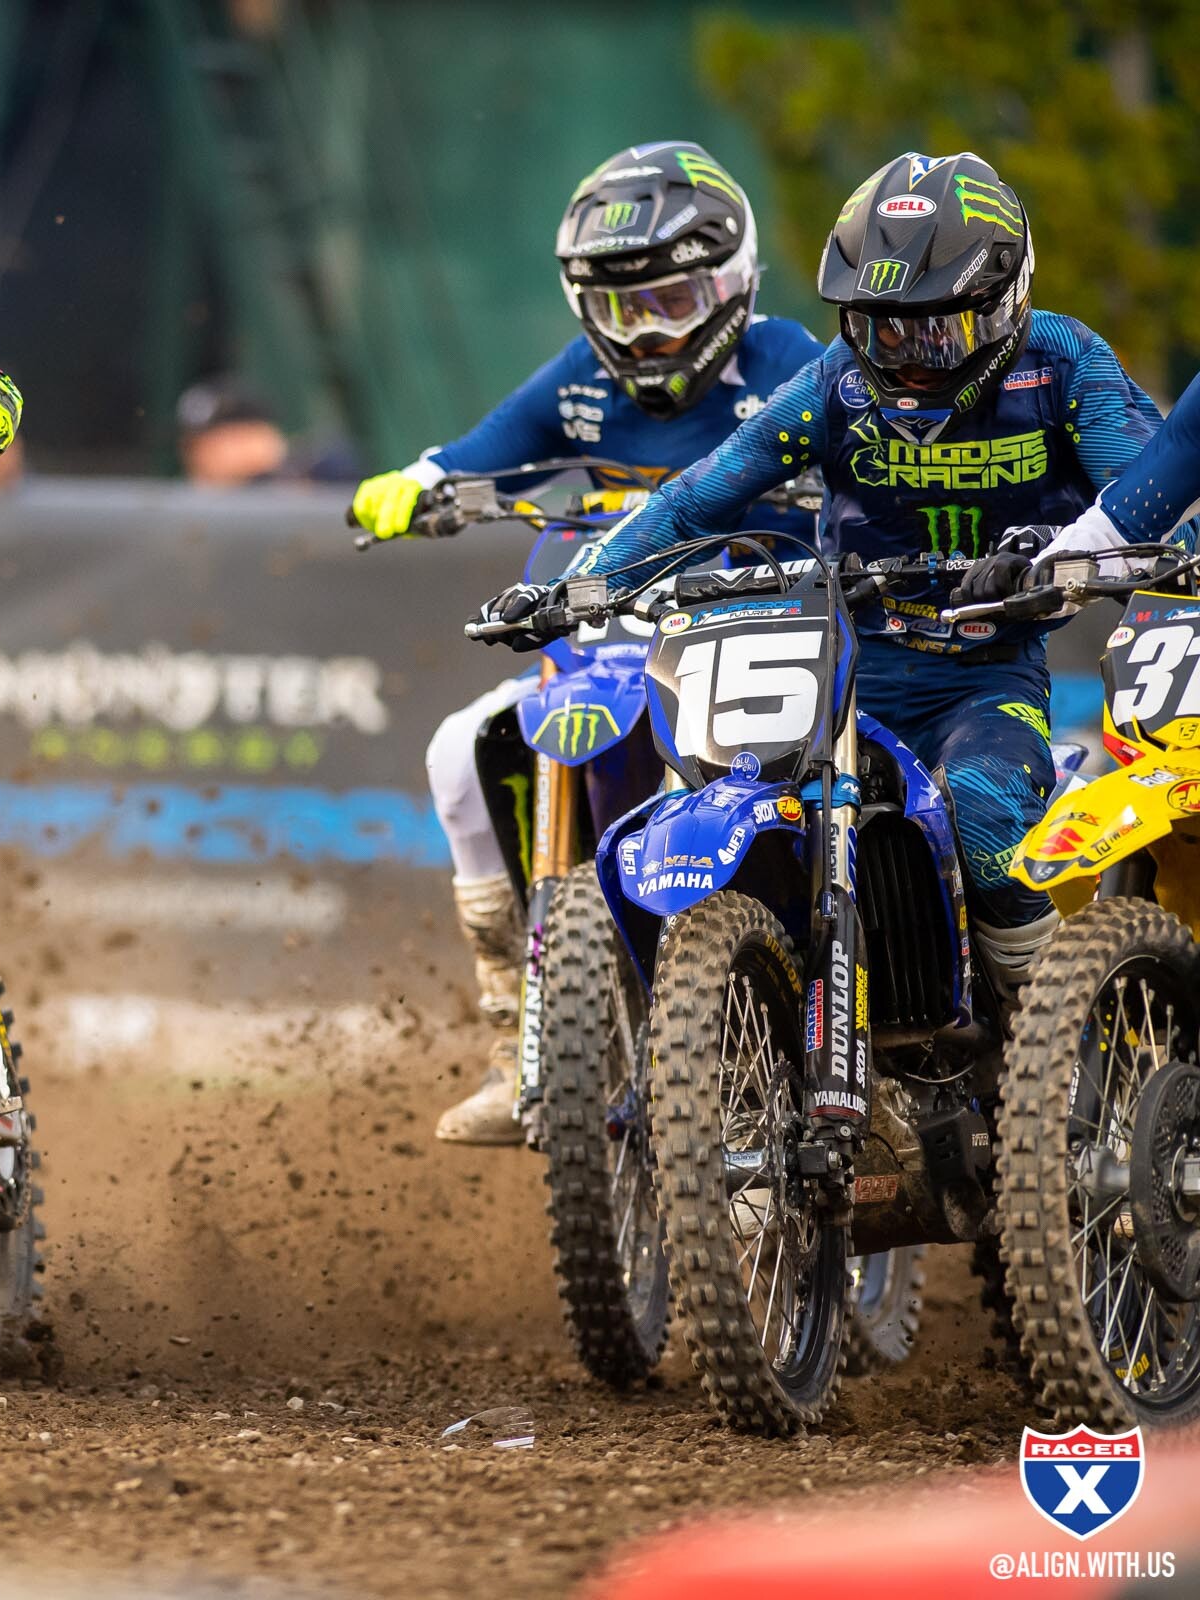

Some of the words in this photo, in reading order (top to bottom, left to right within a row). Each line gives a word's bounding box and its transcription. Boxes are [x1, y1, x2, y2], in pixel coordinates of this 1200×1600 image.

[886, 201, 926, 211] BELL
[1005, 367, 1052, 384] PARTS
[889, 429, 1046, 466] MOOSE
[888, 455, 1047, 489] RACING
[712, 600, 801, 614] SUPERCROSS
[729, 609, 773, 618] FUTURES
[667, 618, 686, 628] AMA
[964, 624, 989, 633] BELL
[673, 630, 823, 757] 15
[778, 802, 803, 817] FMF
[725, 827, 746, 856] UFO
[623, 849, 637, 876] UFO
[637, 872, 713, 896] YAMAHA
[856, 963, 864, 1030] WORKS
[806, 980, 816, 1052] PARTS
[815, 979, 823, 1048] UNLIMITED
[832, 940, 848, 1082] DUNLOP
[814, 1090, 867, 1116] YAMALUBE
